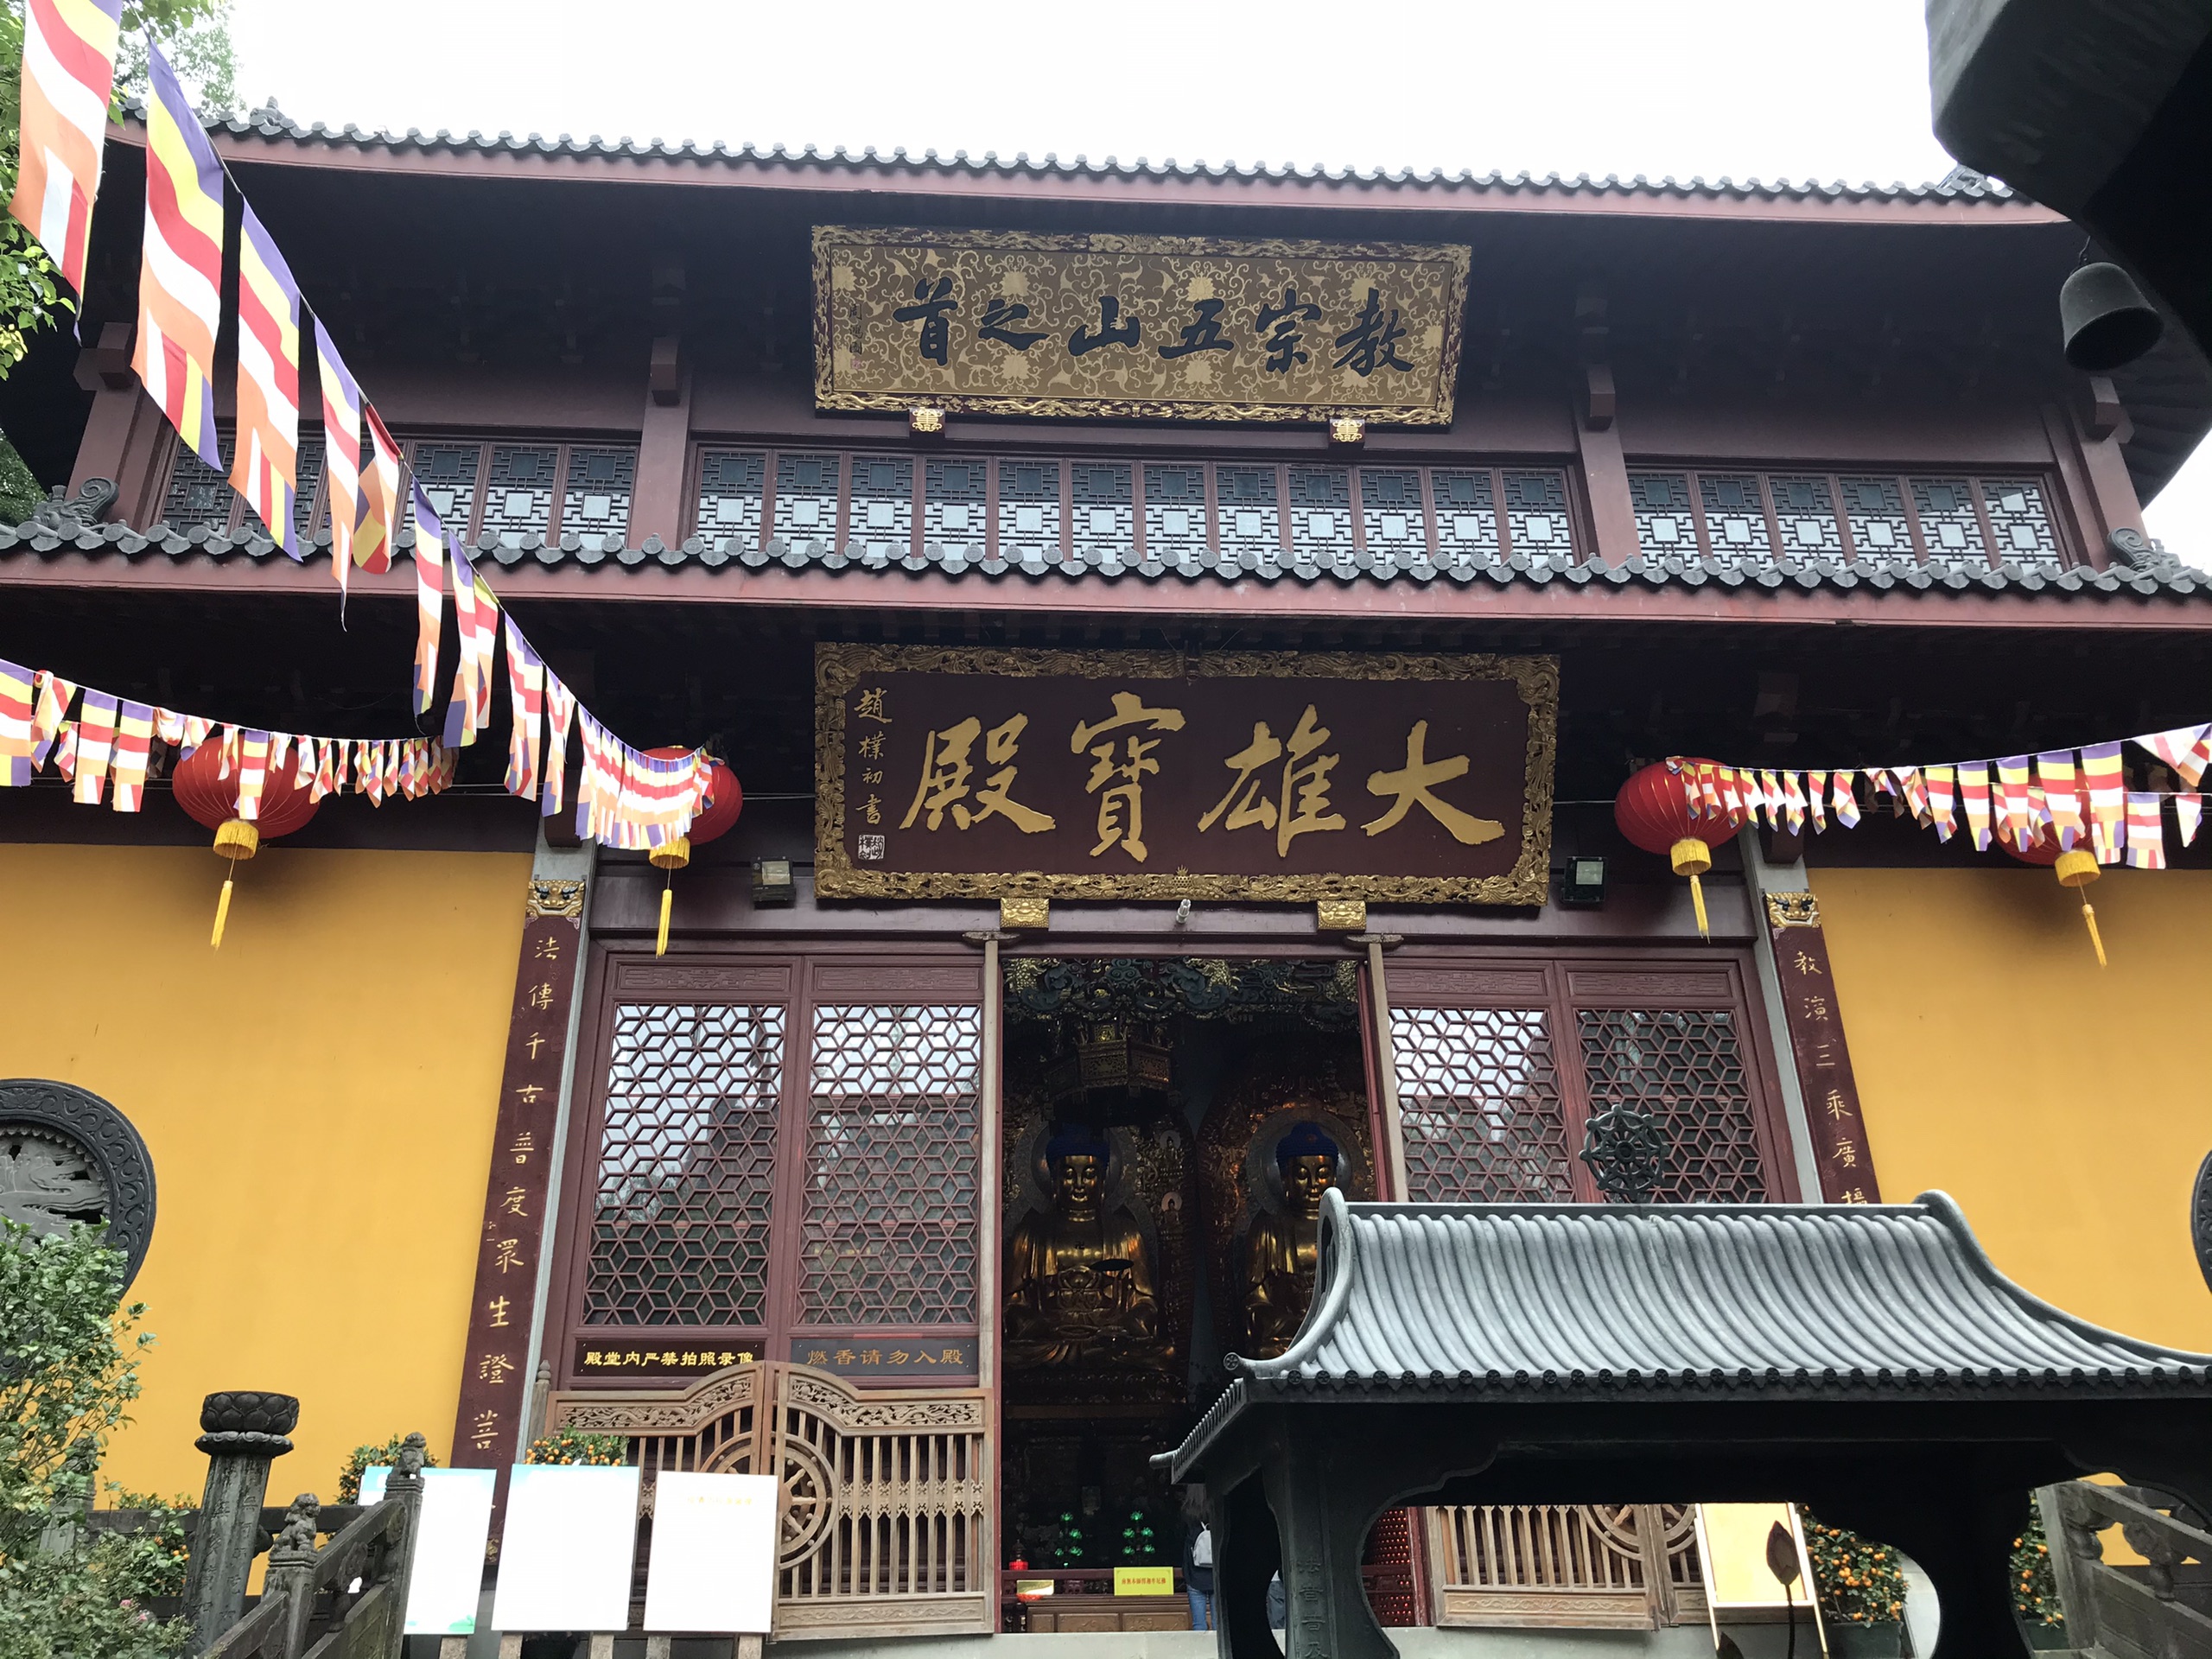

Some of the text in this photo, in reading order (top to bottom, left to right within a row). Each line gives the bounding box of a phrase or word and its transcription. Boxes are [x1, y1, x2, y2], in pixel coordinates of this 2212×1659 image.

[855, 687, 893, 825] 趙樸初書
[899, 691, 1506, 863] 大雄寶殿
[471, 937, 560, 1509] 法傳千古普度眾生證菩
[584, 1351, 753, 1367] 殿堂内严禁拍照录像
[806, 1349, 963, 1366] 燃香请勿入殿
